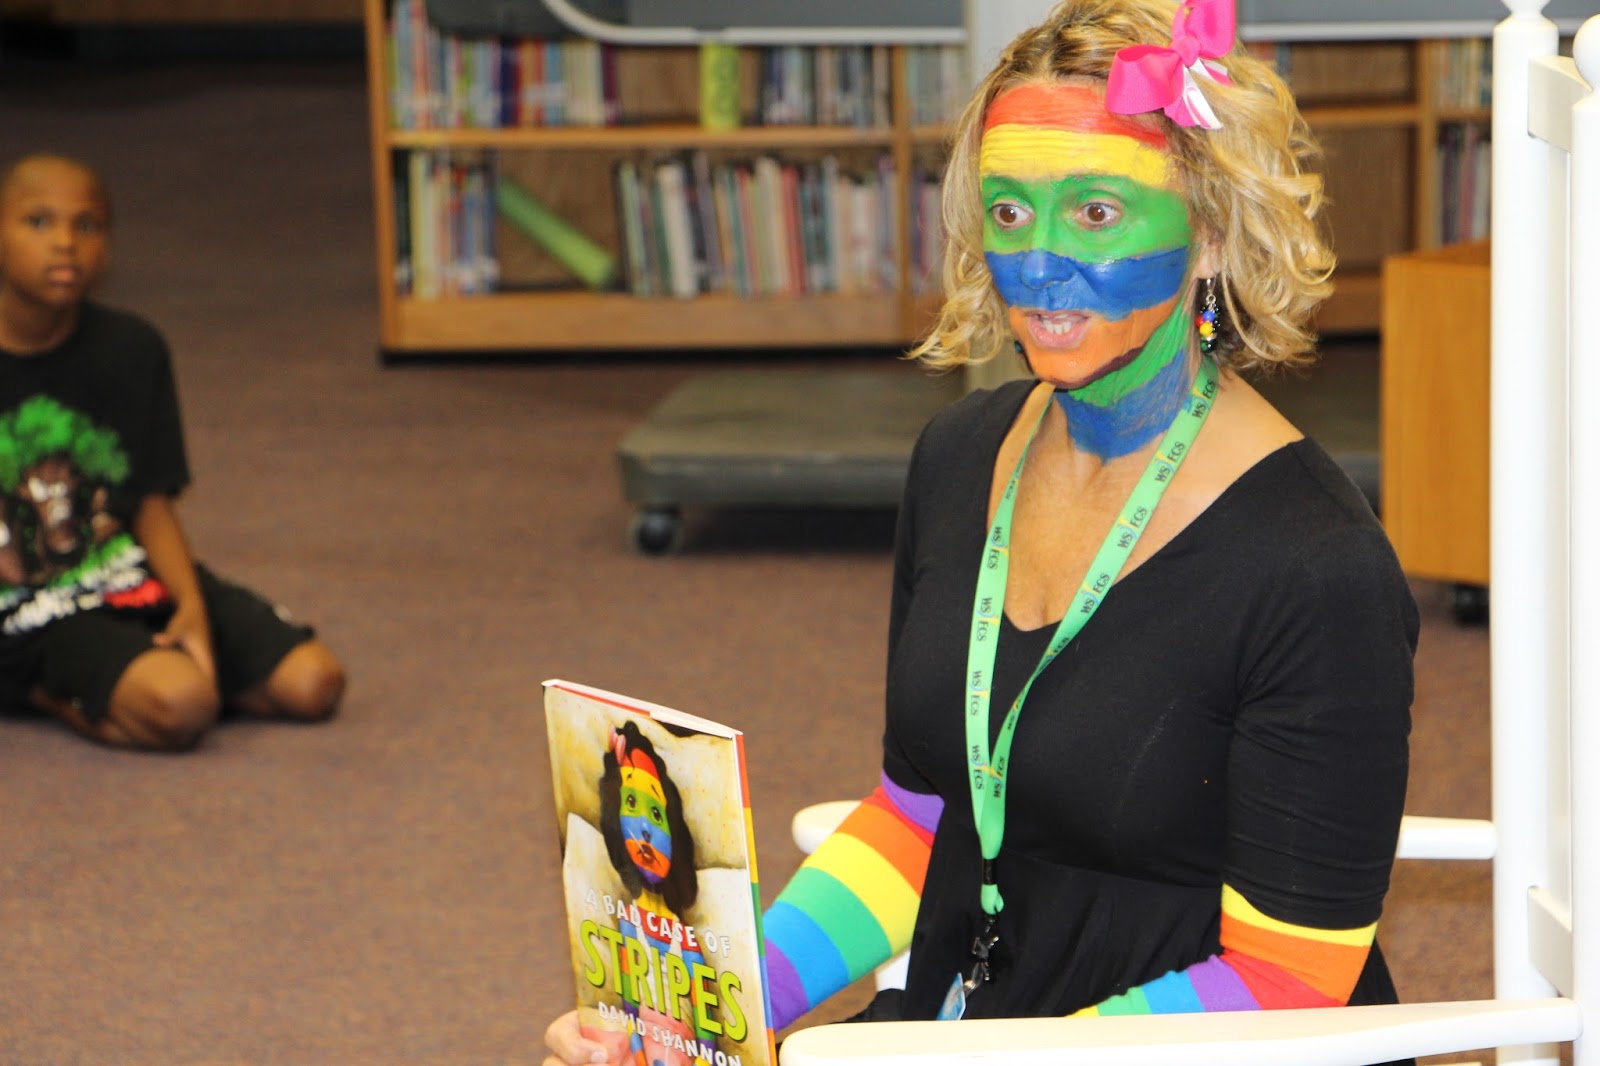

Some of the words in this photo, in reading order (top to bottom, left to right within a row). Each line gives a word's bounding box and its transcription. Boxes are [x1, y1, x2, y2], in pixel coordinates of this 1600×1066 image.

[585, 889, 598, 912] A
[603, 895, 641, 926] BAD
[646, 911, 697, 947] CASE
[704, 931, 731, 958] OF
[580, 919, 748, 1042] STRIPES
[598, 1001, 646, 1036] DAVID
[652, 1025, 743, 1066] SHANNON
